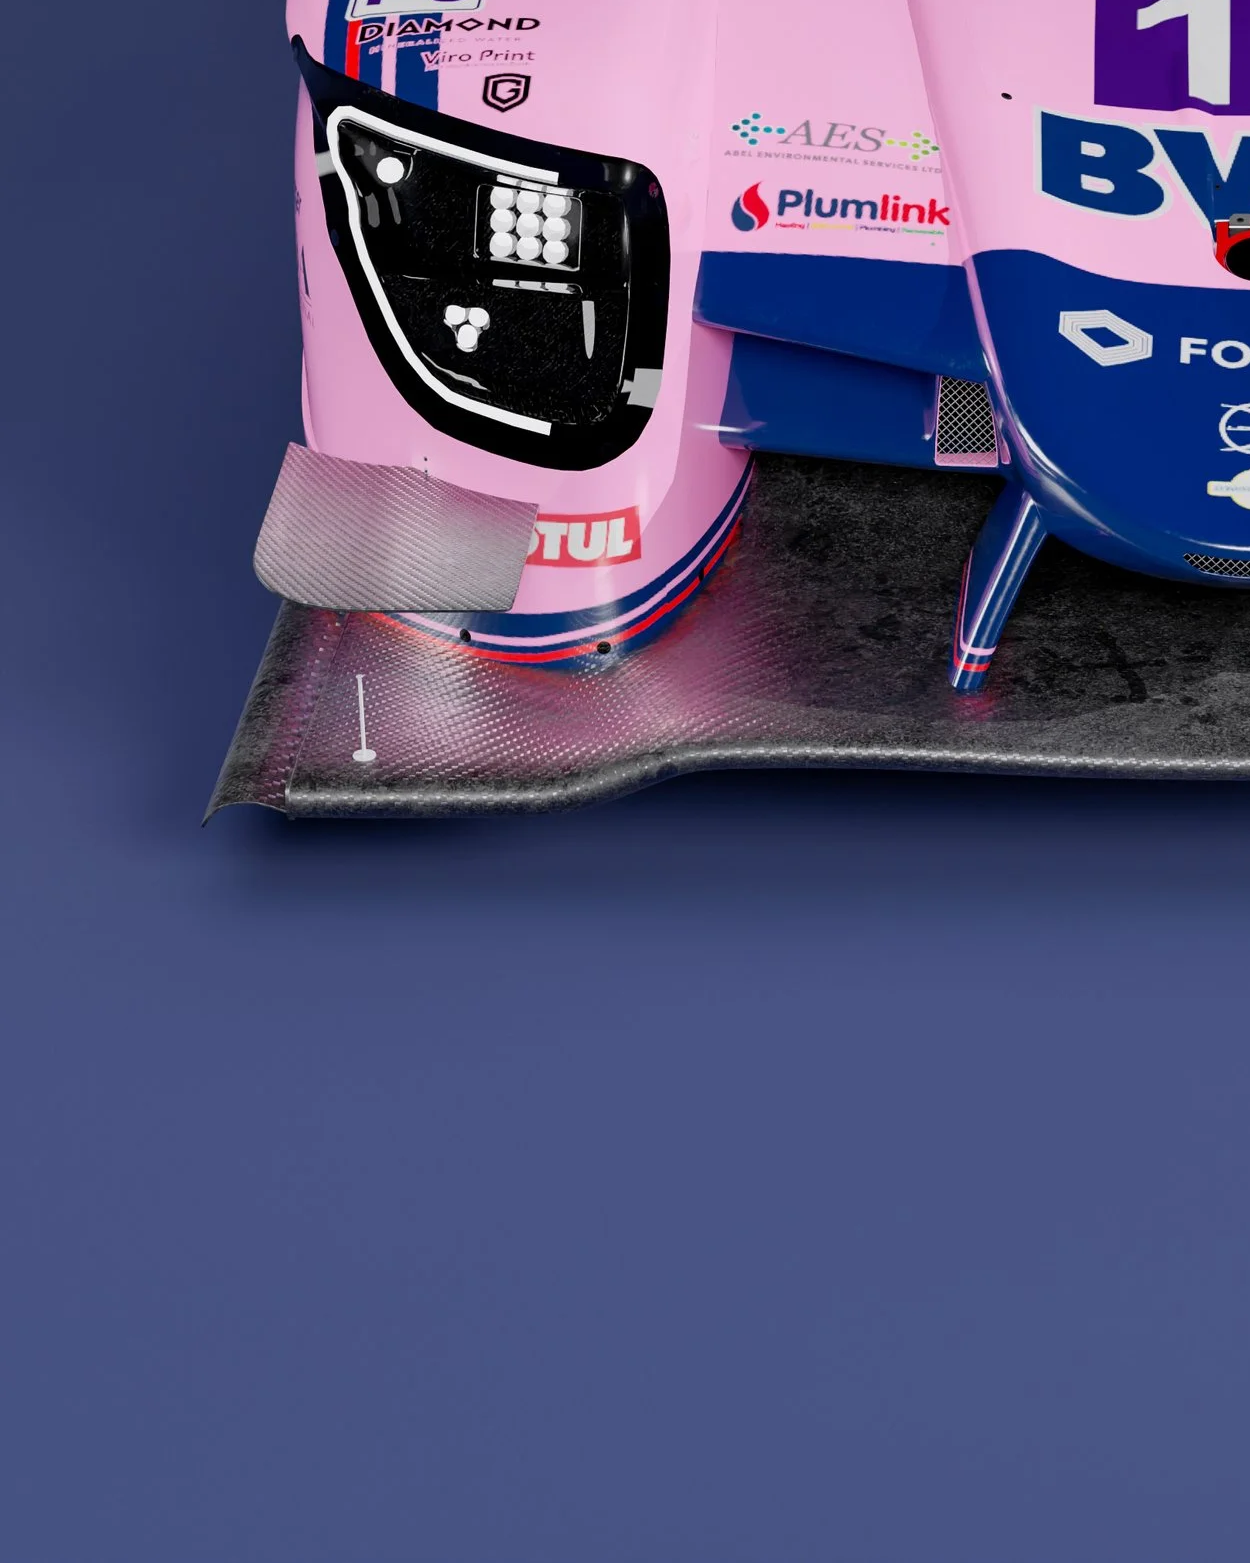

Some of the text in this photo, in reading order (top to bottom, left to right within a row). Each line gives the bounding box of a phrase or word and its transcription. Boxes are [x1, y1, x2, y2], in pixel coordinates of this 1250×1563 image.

[357, 17, 541, 43] DIAMOND
[423, 49, 536, 64] Viro Print
[777, 119, 887, 152] AES
[724, 150, 943, 174] ABEL ENVIRONMENTAL SERVICES LTD
[777, 188, 951, 226] Plumlink
